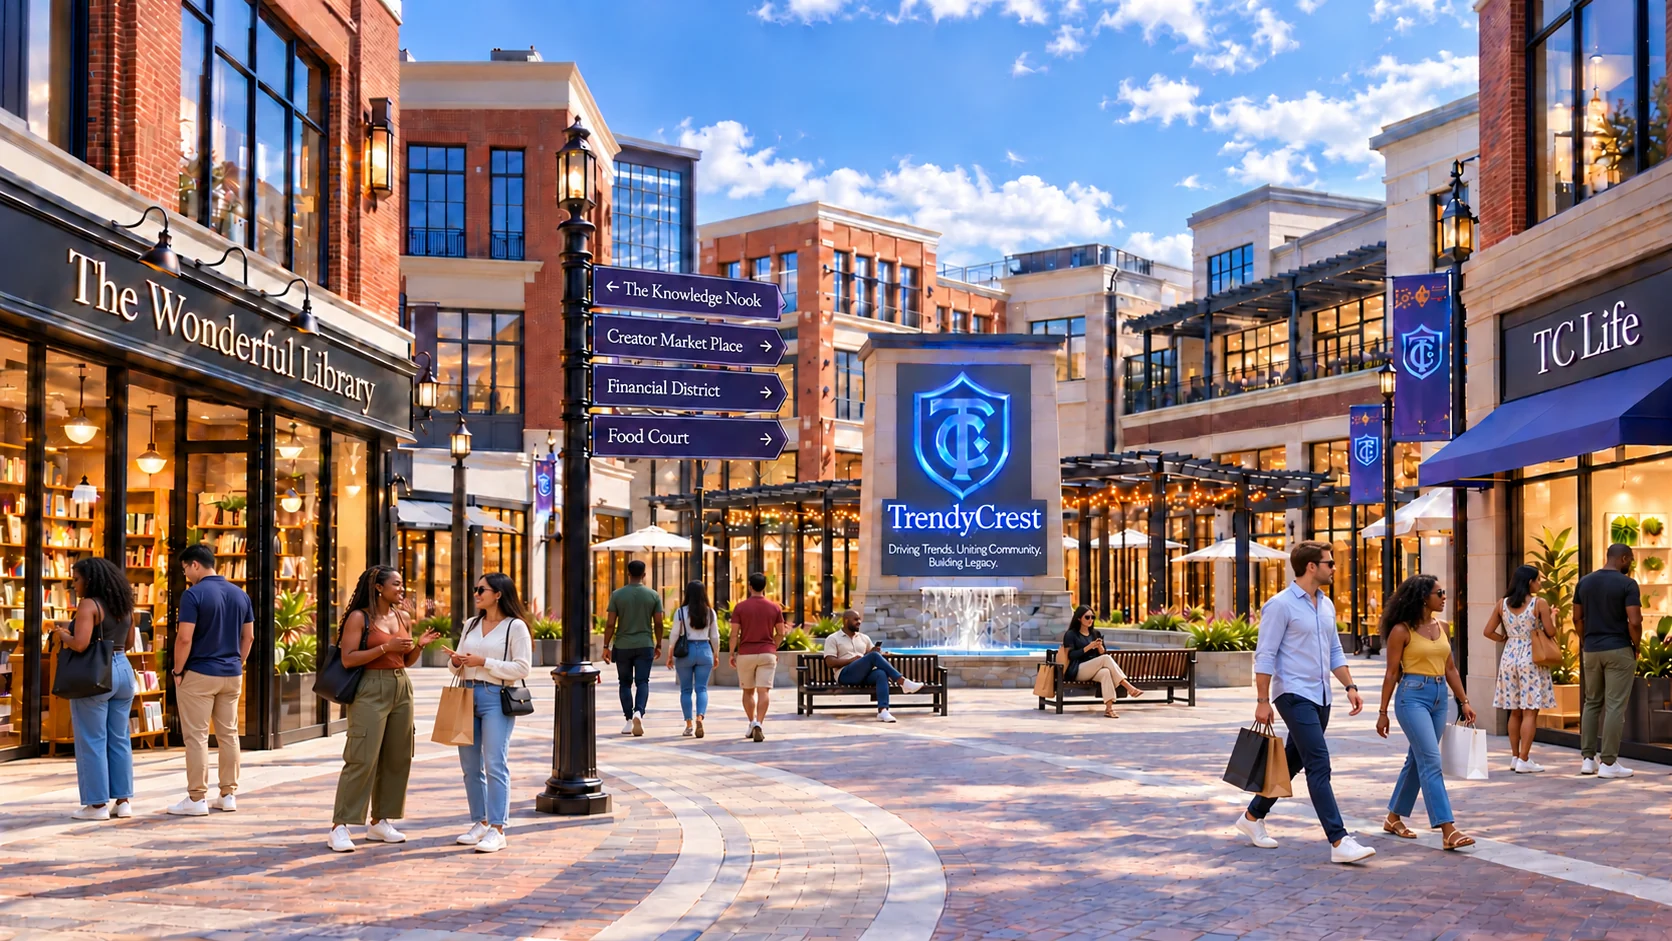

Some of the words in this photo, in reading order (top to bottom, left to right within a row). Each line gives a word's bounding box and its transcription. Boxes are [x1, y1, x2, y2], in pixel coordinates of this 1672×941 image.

[623, 281, 648, 297] The
[651, 284, 723, 307] Knowledge
[725, 290, 762, 308] Nook
[68, 248, 139, 322] The
[146, 279, 297, 378] Wonderful
[301, 345, 376, 415] Library
[607, 328, 657, 346] Creator
[660, 332, 708, 350] Market
[710, 336, 743, 352] Place
[1533, 320, 1575, 375] TC
[1580, 300, 1640, 360] Life
[607, 378, 667, 395] Financial
[671, 380, 721, 397] District
[607, 428, 644, 444] Food
[648, 429, 690, 445] Court
[887, 503, 1042, 536] TrendyCrest
[888, 544, 921, 557] Driving
[922, 544, 955, 555] Trends.
[956, 544, 988, 557] Uniting
[988, 544, 1042, 557] Community.
[928, 557, 963, 569] Building
[965, 557, 998, 569] Legacy.
